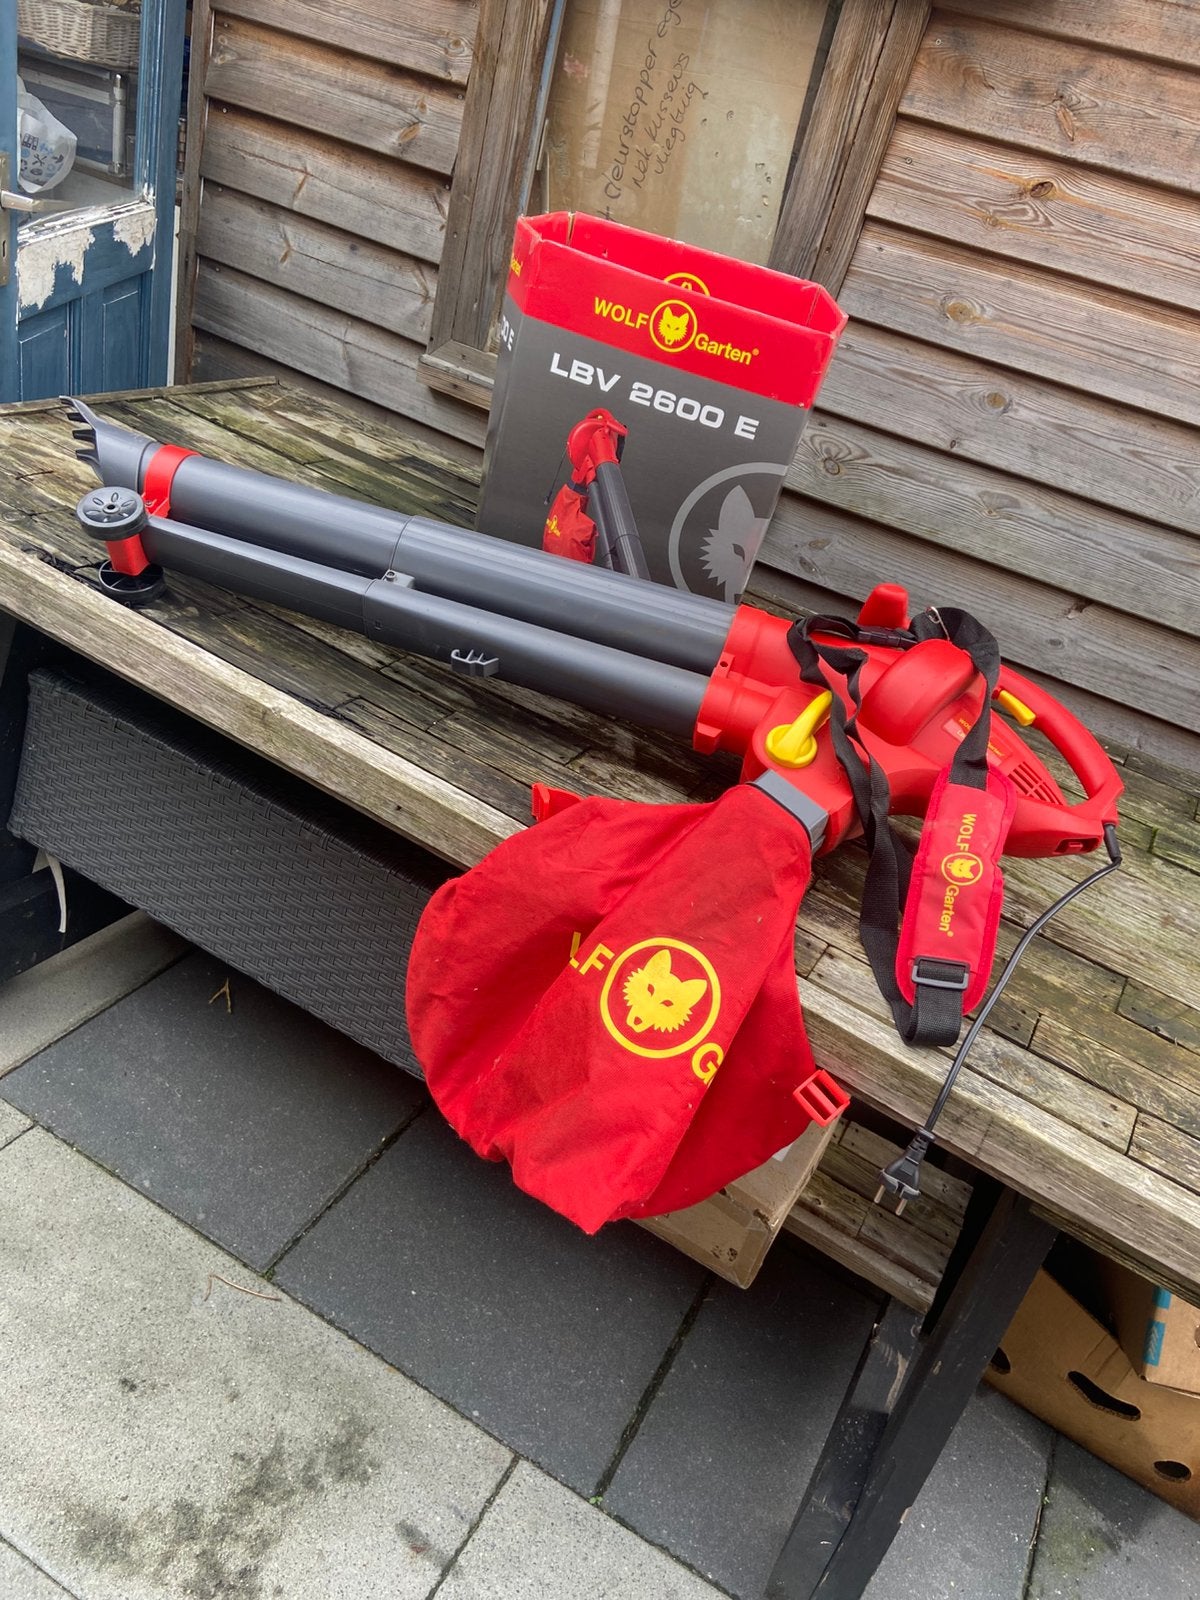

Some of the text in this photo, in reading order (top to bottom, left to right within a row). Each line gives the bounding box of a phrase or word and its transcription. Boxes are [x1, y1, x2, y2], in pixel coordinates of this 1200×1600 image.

[602, 39, 657, 200] deurstopper
[593, 296, 650, 330] WOLF
[549, 352, 760, 441] LBV 2600 E
[956, 812, 978, 853] WOLF
